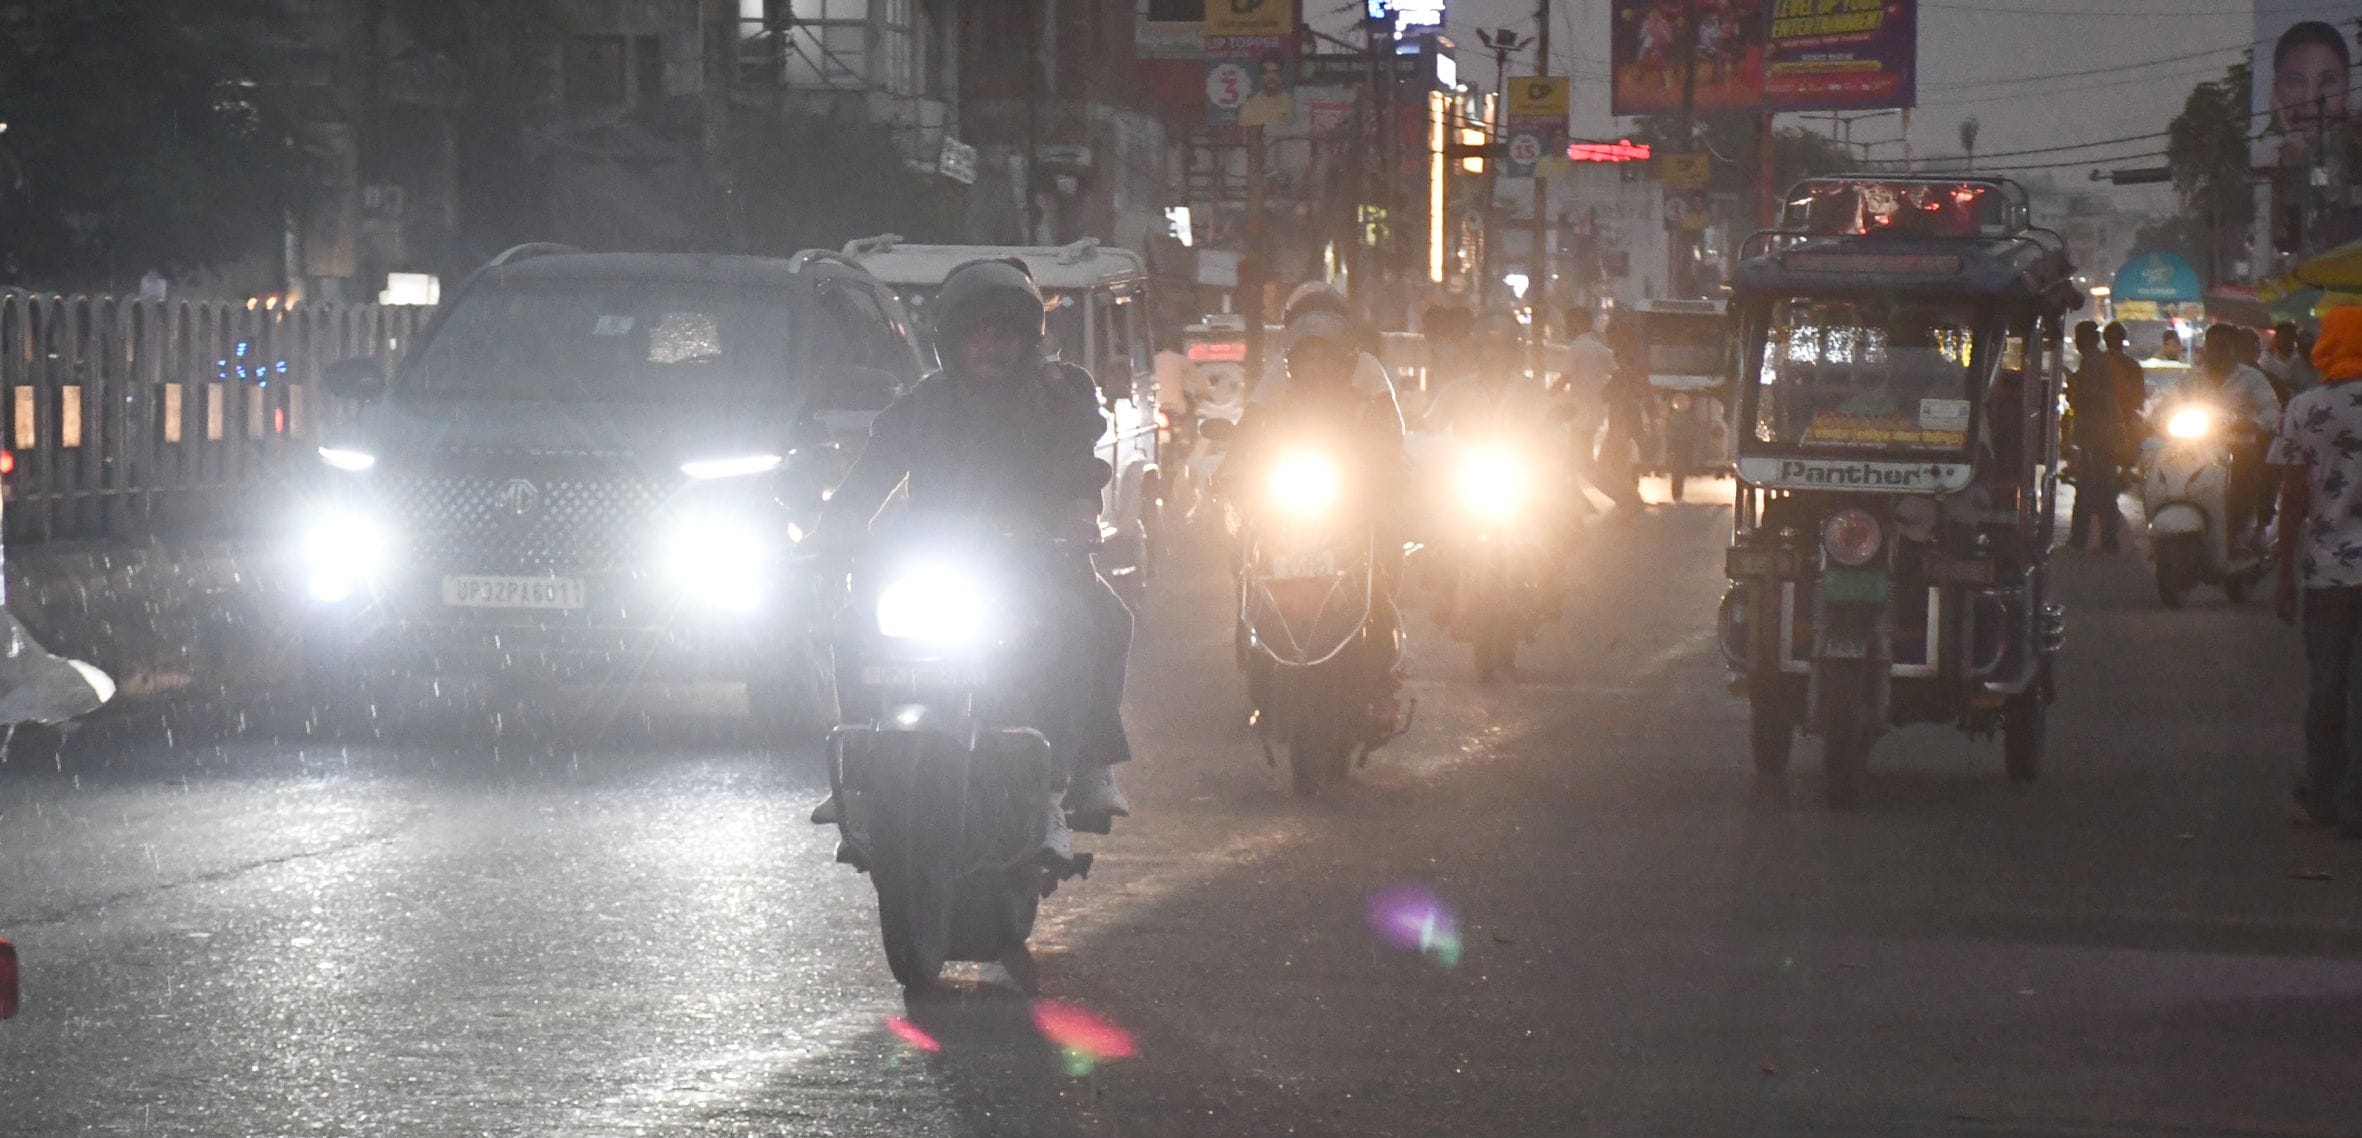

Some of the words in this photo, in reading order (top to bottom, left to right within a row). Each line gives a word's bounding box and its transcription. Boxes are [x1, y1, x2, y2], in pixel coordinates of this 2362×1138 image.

[1219, 78, 1240, 104] 3
[1515, 144, 1535, 159] 15
[1780, 460, 1920, 485] Panther
